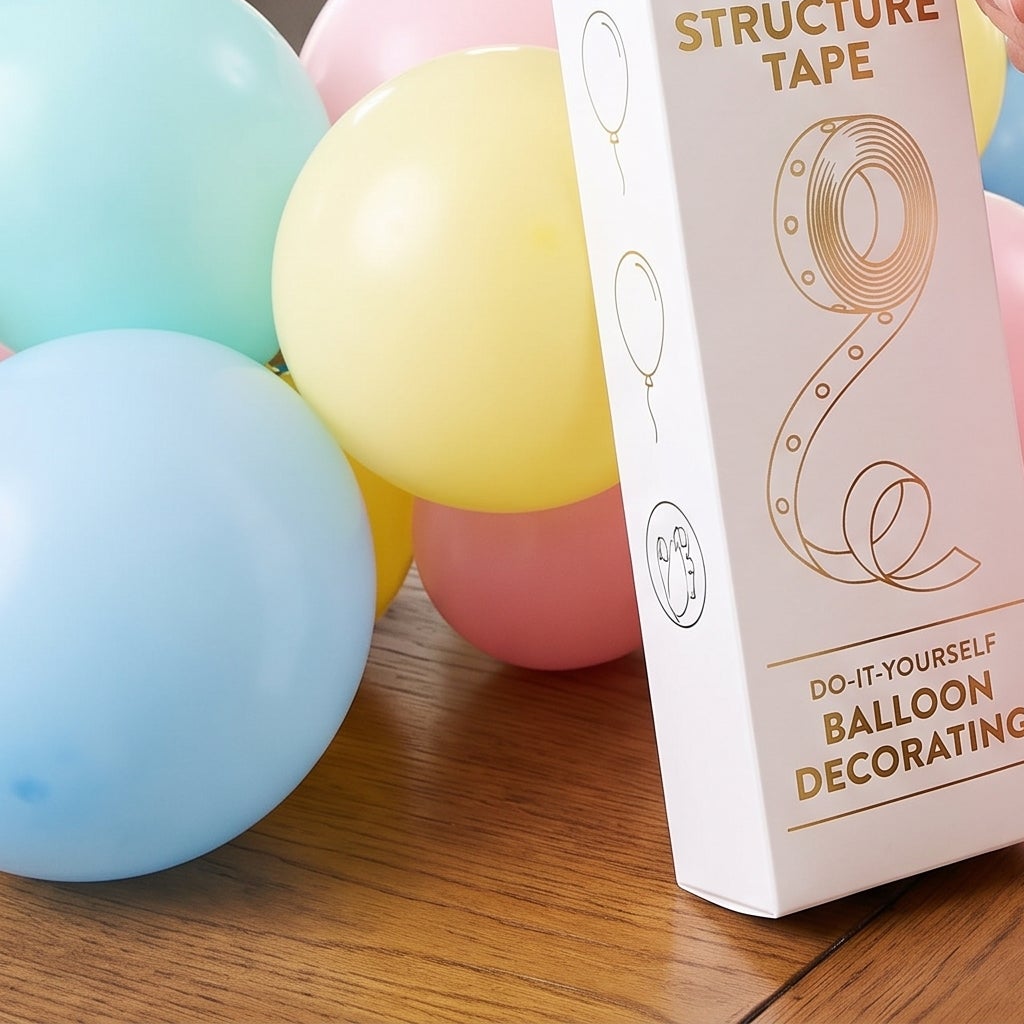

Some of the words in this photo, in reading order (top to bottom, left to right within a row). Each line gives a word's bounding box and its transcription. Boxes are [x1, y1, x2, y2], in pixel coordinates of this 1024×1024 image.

[762, 41, 874, 91] TAPE
[810, 632, 996, 700] DO-IT-YOURSELF
[823, 670, 993, 745] BALLOON
